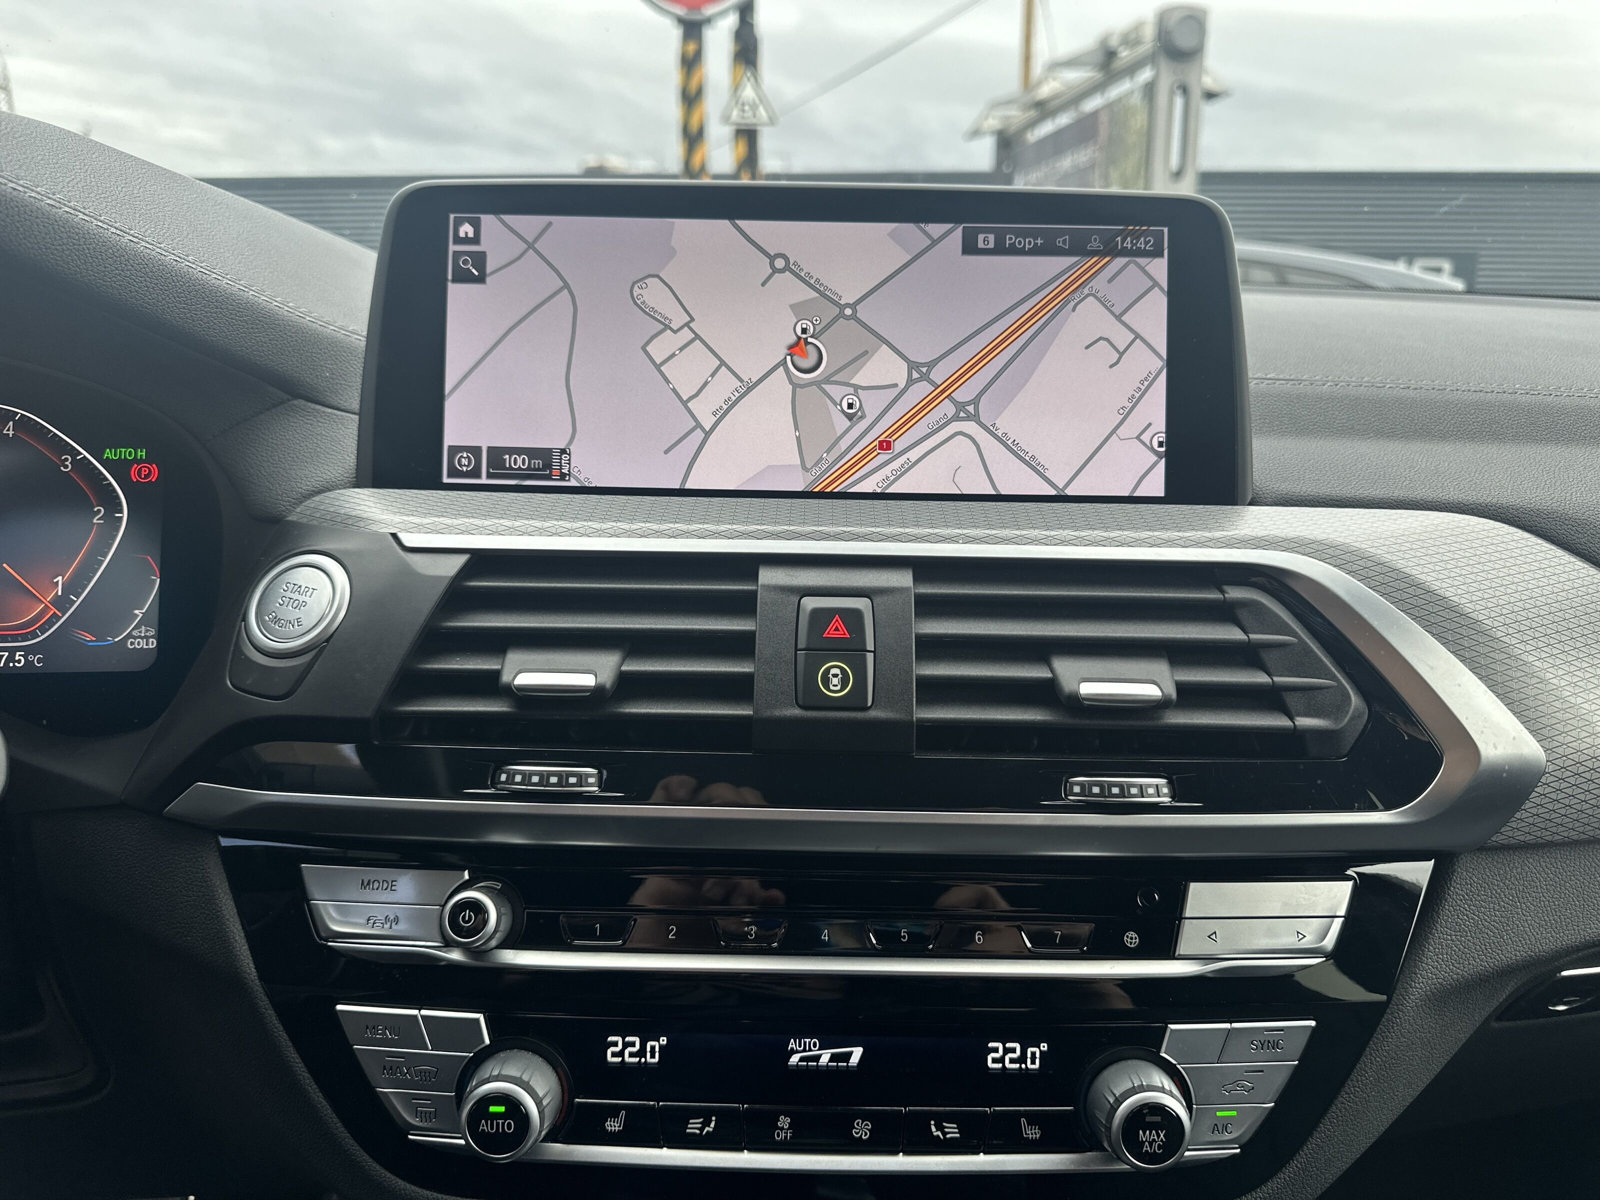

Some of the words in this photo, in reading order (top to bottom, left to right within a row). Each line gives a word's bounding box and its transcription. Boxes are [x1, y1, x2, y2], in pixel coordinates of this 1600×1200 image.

[981, 236, 990, 246] 6
[1005, 235, 1044, 251] Pop+
[1115, 236, 1154, 250] 14:42
[791, 260, 805, 274] Rte
[803, 271, 814, 281] de
[813, 277, 843, 302] Begnins
[1070, 289, 1085, 302] Rue
[1087, 286, 1100, 295] du
[1099, 294, 1115, 309] Jura
[635, 293, 673, 325] Gaudenies
[711, 405, 725, 418] Rte
[723, 396, 733, 406] de
[730, 377, 754, 398] l'Etraz
[1116, 405, 1130, 416] Ch.
[1127, 393, 1137, 404] de
[1133, 386, 1143, 395] la
[926, 412, 949, 431] Gland
[3, 421, 15, 438] 4
[103, 448, 135, 460] AUTO
[137, 448, 146, 459] H
[989, 422, 1001, 434] Av.
[1000, 431, 1012, 442] du
[1010, 439, 1050, 474] Mont-Blanc
[60, 455, 72, 472] 3
[503, 454, 529, 469] 100
[531, 459, 543, 468] m
[561, 454, 570, 474] AUTO
[809, 458, 831, 478] Gland
[571, 465, 583, 478] Ch.
[583, 477, 593, 486] de
[875, 457, 913, 489] Cité-Ouest
[92, 506, 105, 524] 2
[53, 575, 63, 596] 1
[282, 581, 318, 599] START
[278, 595, 307, 611] STOP
[266, 610, 303, 630] ENGINE
[127, 638, 157, 649] COLD
[28, 654, 44, 667] °C
[360, 878, 398, 892] MODE
[594, 923, 601, 937] 1
[668, 925, 677, 939] 2
[746, 926, 756, 940] 3
[820, 928, 829, 943] 4
[900, 928, 908, 942] 5
[974, 930, 983, 945] 6
[1054, 930, 1062, 944] 7
[364, 1024, 401, 1039] MENU
[788, 1038, 819, 1051] AUTO
[1250, 1038, 1284, 1053] SYNC
[478, 1119, 515, 1133] AUTO
[1211, 1122, 1233, 1136] A/C
[774, 1129, 793, 1141] OFF
[1138, 1130, 1166, 1143] MAX
[1142, 1141, 1163, 1154] A/C
